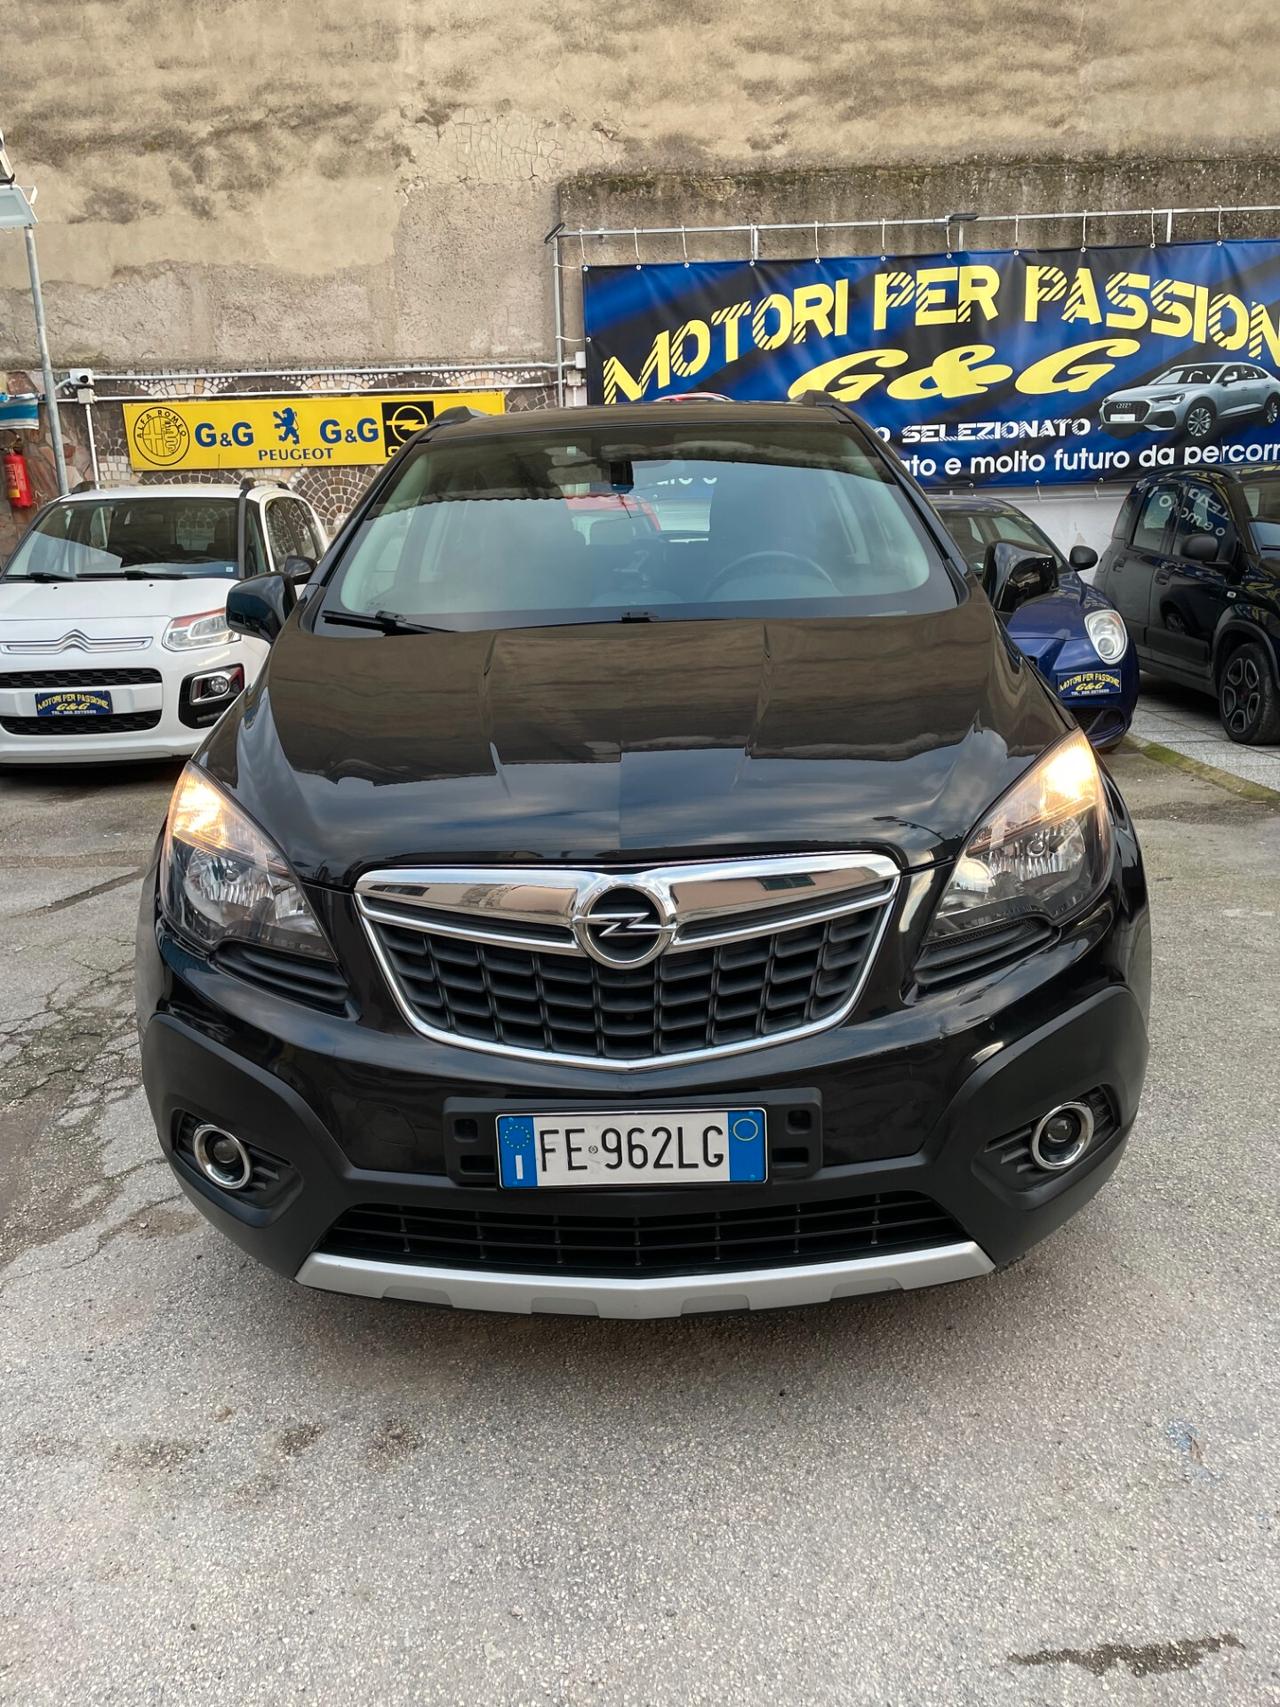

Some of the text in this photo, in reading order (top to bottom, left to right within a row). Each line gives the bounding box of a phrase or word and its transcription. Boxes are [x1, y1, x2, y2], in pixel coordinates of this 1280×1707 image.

[603, 279, 849, 404] MOTORI
[873, 265, 1000, 331] PER
[787, 338, 1141, 402] G&G
[137, 410, 187, 438] ALFA ROMEO
[194, 421, 254, 447] G&G
[320, 418, 379, 444] G&G
[901, 418, 1092, 443] SELEZIONATO
[258, 447, 333, 461] PEUGEOT
[944, 457, 962, 475] e
[970, 449, 1046, 474] molto
[1053, 447, 1131, 471] futuro
[1138, 444, 1175, 468] da
